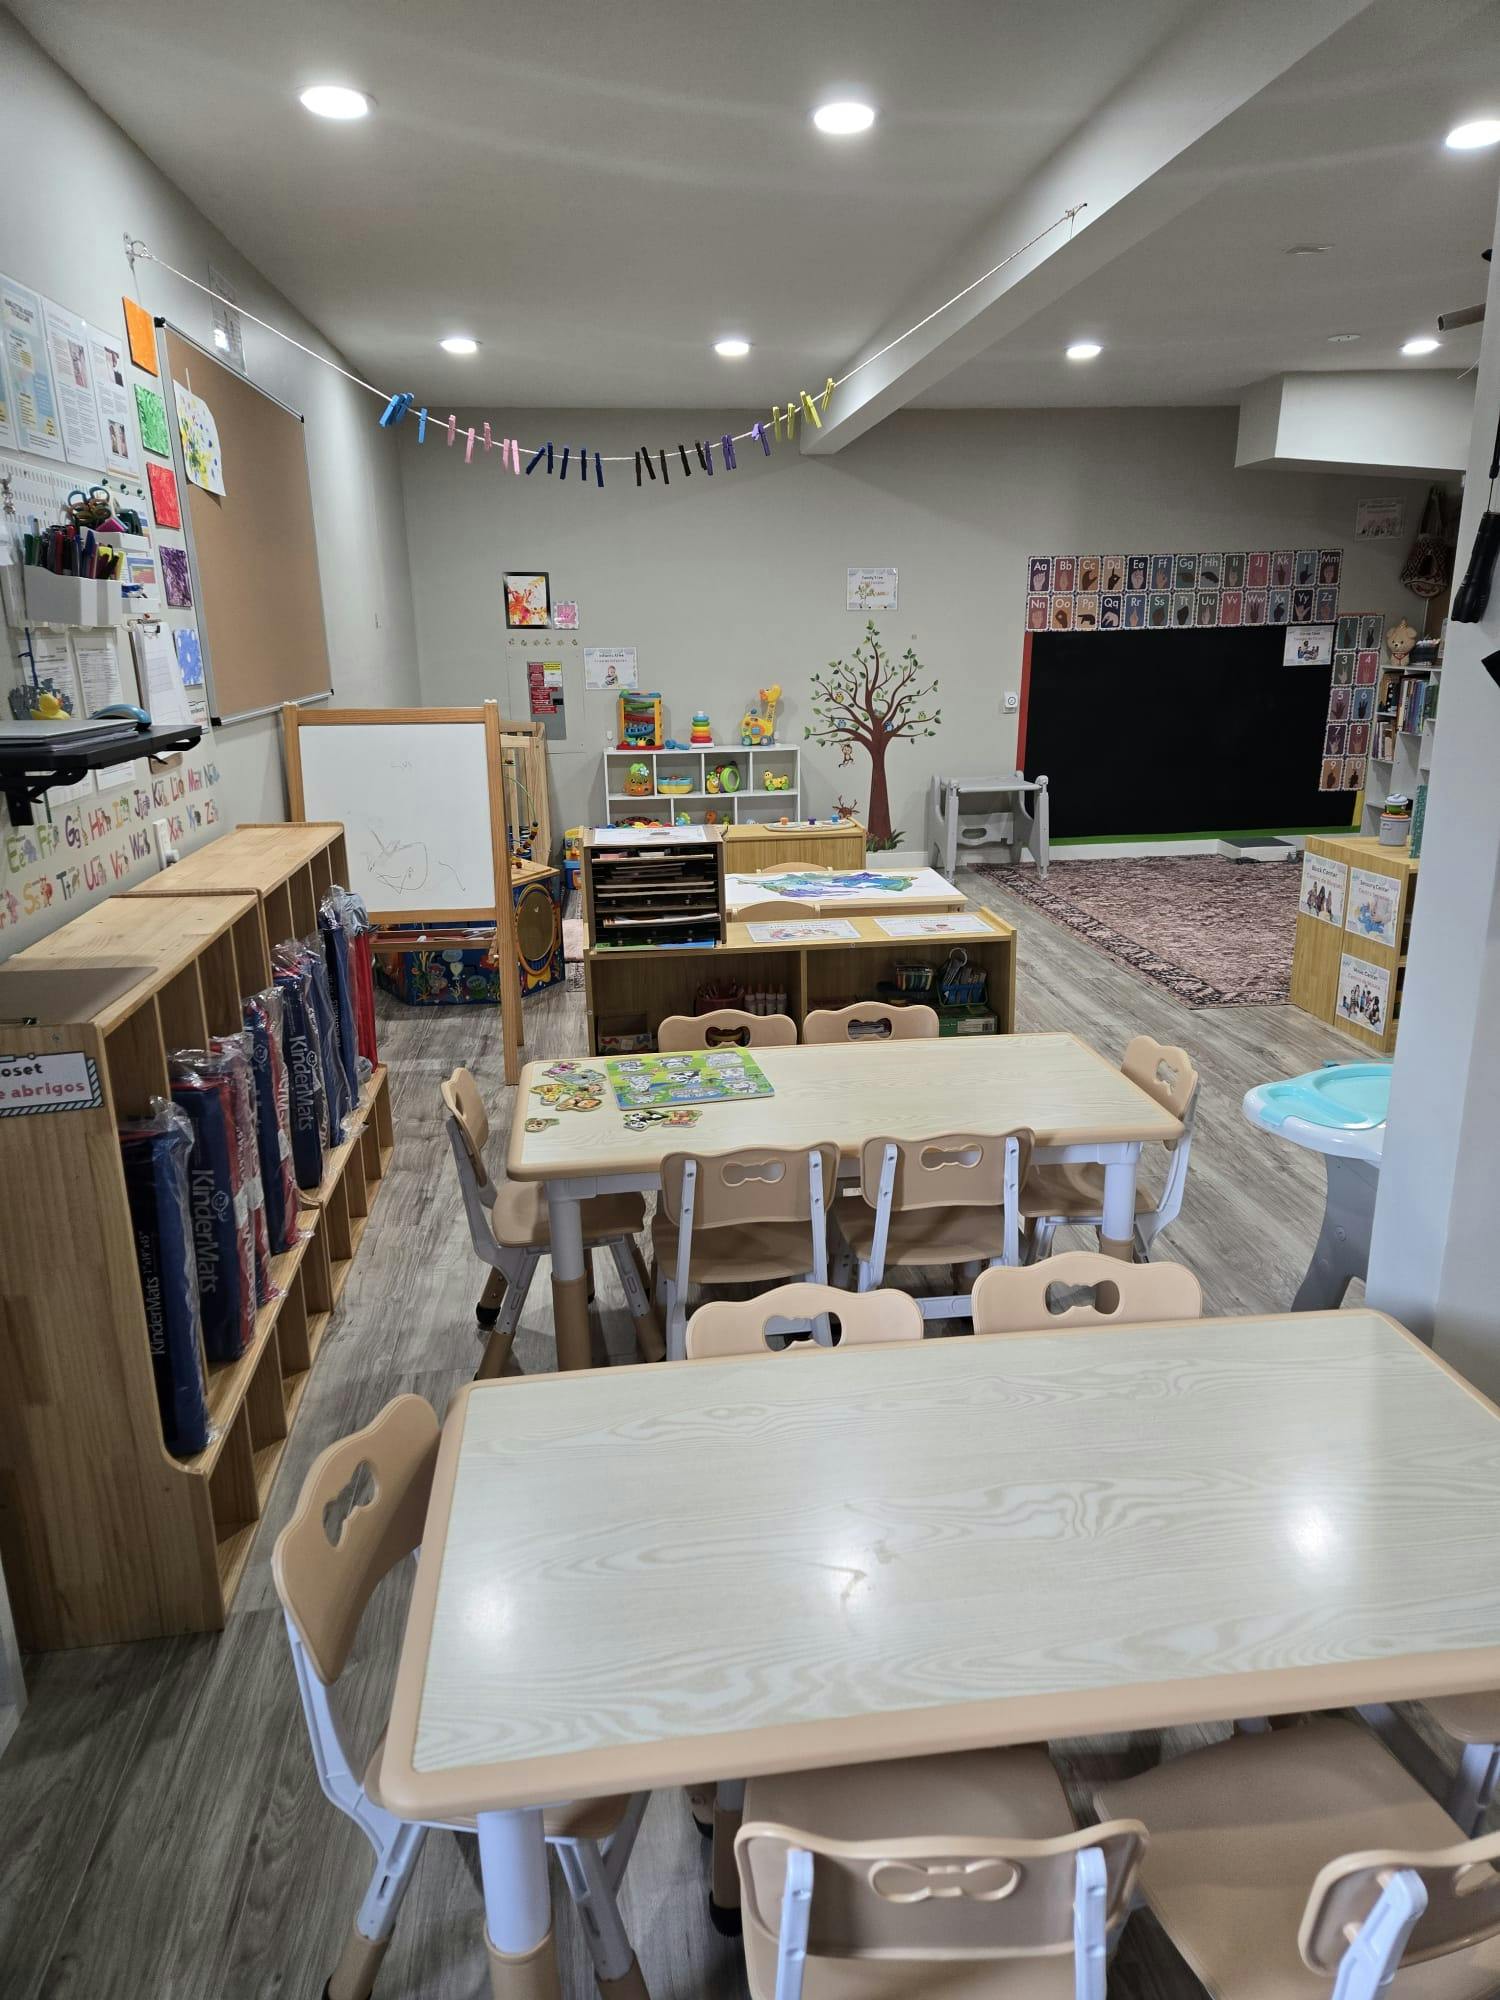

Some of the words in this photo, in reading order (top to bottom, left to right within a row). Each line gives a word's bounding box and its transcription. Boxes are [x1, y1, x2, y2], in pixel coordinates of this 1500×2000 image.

[1033, 562, 1047, 571] Aa
[1060, 560, 1072, 571] Bb
[1082, 560, 1095, 570] Cc
[1107, 560, 1121, 570] Dd
[1133, 559, 1145, 569] Ee
[1158, 559, 1168, 568] Ff
[1180, 559, 1194, 569] Gg
[1204, 558, 1218, 567] Hh
[1232, 557, 1239, 567] Ii
[1277, 556, 1289, 565] Kk
[1322, 555, 1340, 563] Mm
[1031, 600, 1046, 609] Nn
[1055, 599, 1070, 609] Oo
[1082, 599, 1094, 609] Pp
[1104, 599, 1119, 609] Qq
[1131, 598, 1141, 607] Rr
[1154, 597, 1165, 606] Ss
[1201, 597, 1216, 606] Uu
[1227, 596, 1238, 605] Vv
[1247, 594, 1266, 603] Ww
[1275, 594, 1286, 603] Xx
[1298, 593, 1308, 604] Yy
[1322, 592, 1332, 602] Zz
[1369, 619, 1376, 628] 2
[1341, 655, 1348, 664] 3
[1365, 655, 1371, 664] 4
[1337, 691, 1344, 700] 5
[1360, 690, 1367, 699] 6
[1335, 726, 1341, 735] 7
[1356, 726, 1362, 735] 8
[1330, 761, 1336, 769] 9
[1351, 760, 1361, 769] 10
[6, 835, 26, 873] Ee
[65, 815, 81, 848] Gg
[88, 809, 106, 840] Hh
[23, 882, 41, 915] Ss
[56, 870, 72, 900] Tt
[0, 1063, 43, 1077] oset
[11, 1082, 86, 1099] abrigos
[289, 1035, 315, 1131] KinderMats
[191, 1169, 220, 1293] KinderMats
[151, 1276, 165, 1355] KinderMats
